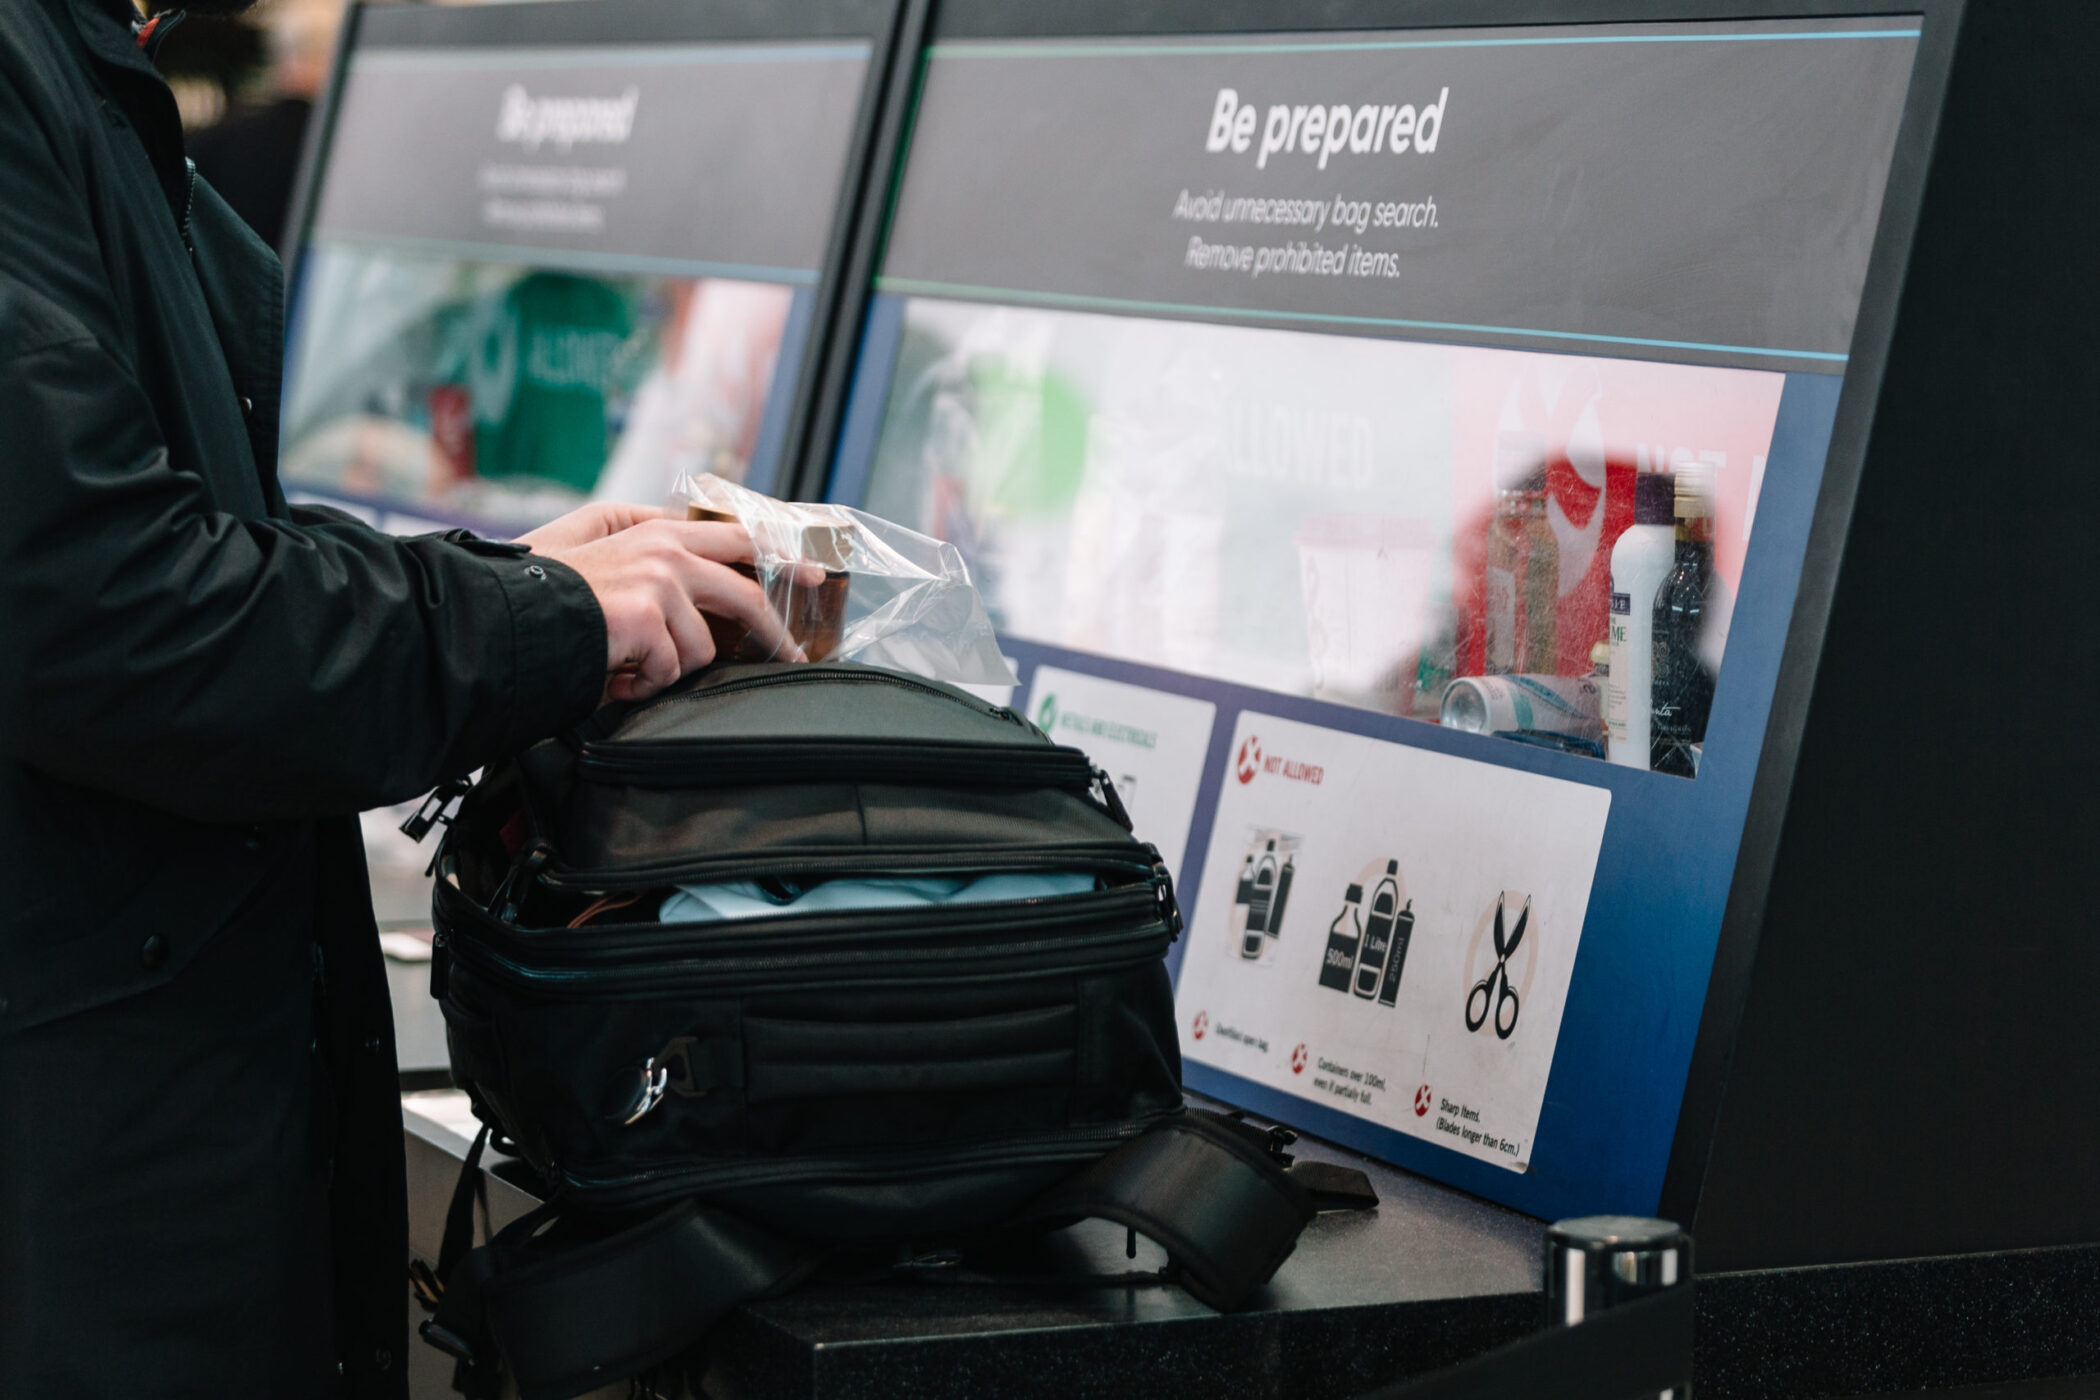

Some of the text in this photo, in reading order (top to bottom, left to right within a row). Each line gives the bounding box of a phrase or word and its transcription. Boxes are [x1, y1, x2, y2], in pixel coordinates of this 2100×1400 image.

[1205, 85, 1450, 171] Be prepared
[1173, 188, 1439, 235] Avoid unnecessary bag search.
[1185, 234, 1400, 278] Remove prohibited items.
[1264, 755, 1324, 785] NOT ALLOWED
[1440, 1098, 1460, 1117] Sharp
[1436, 1117, 1520, 1157] (Blades longer than 6cm.)
